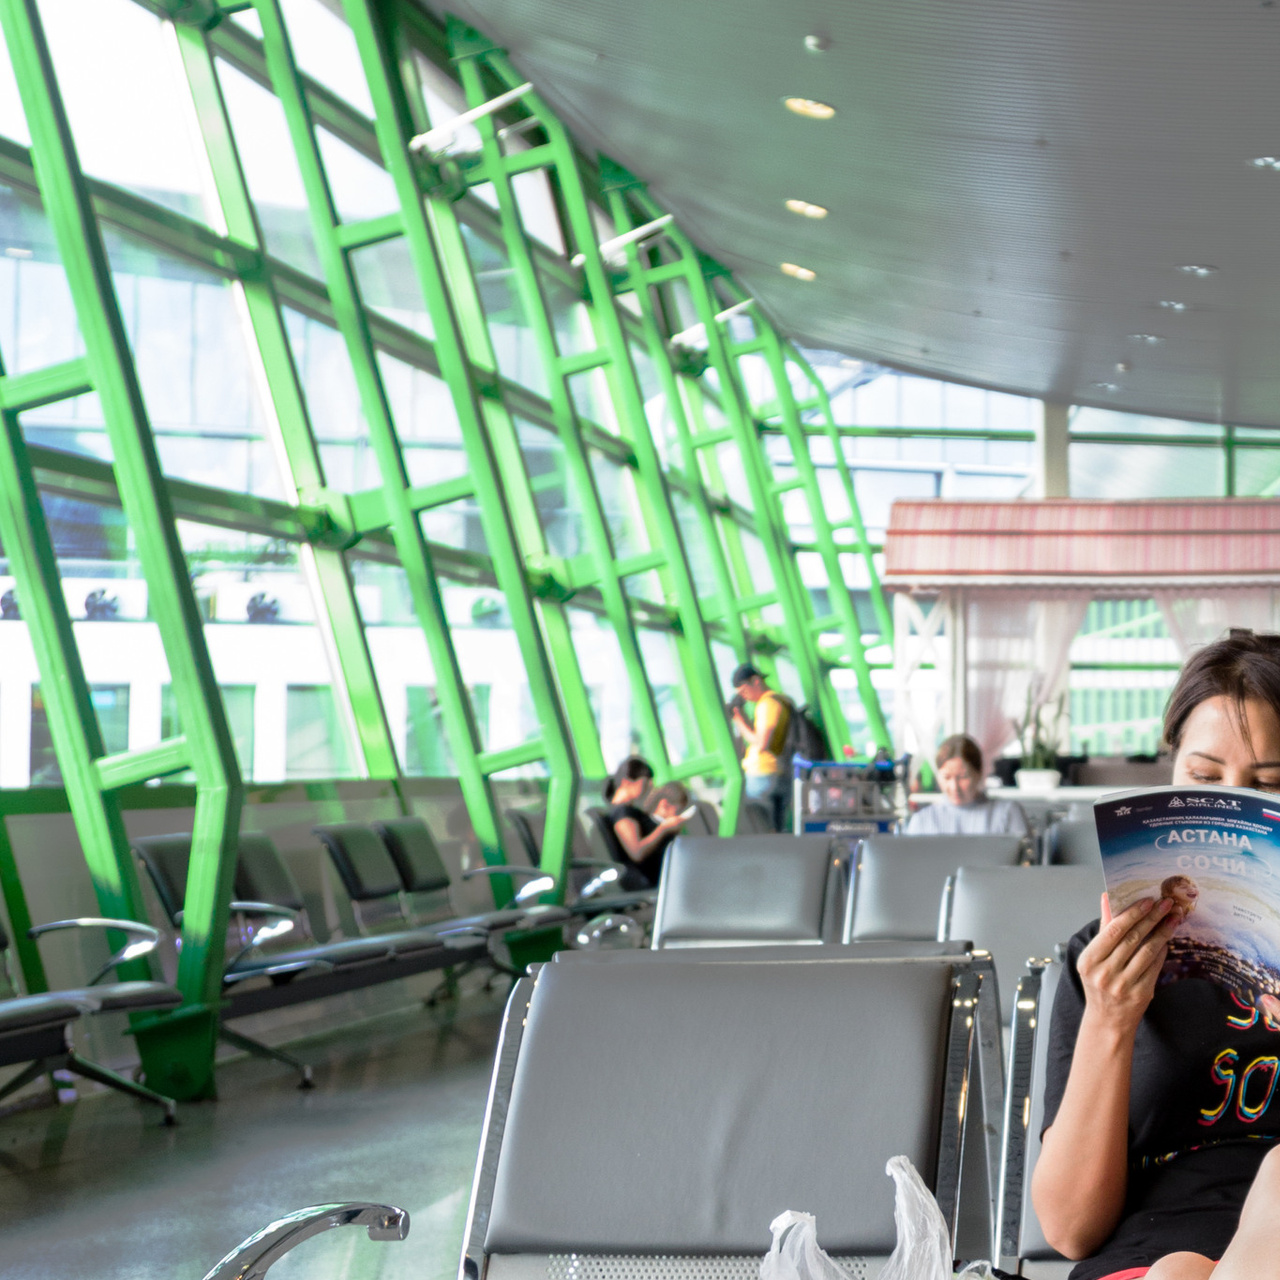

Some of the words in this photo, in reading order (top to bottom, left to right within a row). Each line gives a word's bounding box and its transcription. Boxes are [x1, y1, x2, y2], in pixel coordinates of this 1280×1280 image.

[1186, 797, 1241, 807] SCAT
[1187, 802, 1242, 811] AIRLINES
[1167, 828, 1253, 851] АСТАНА
[1176, 854, 1247, 876] СОЧИ
